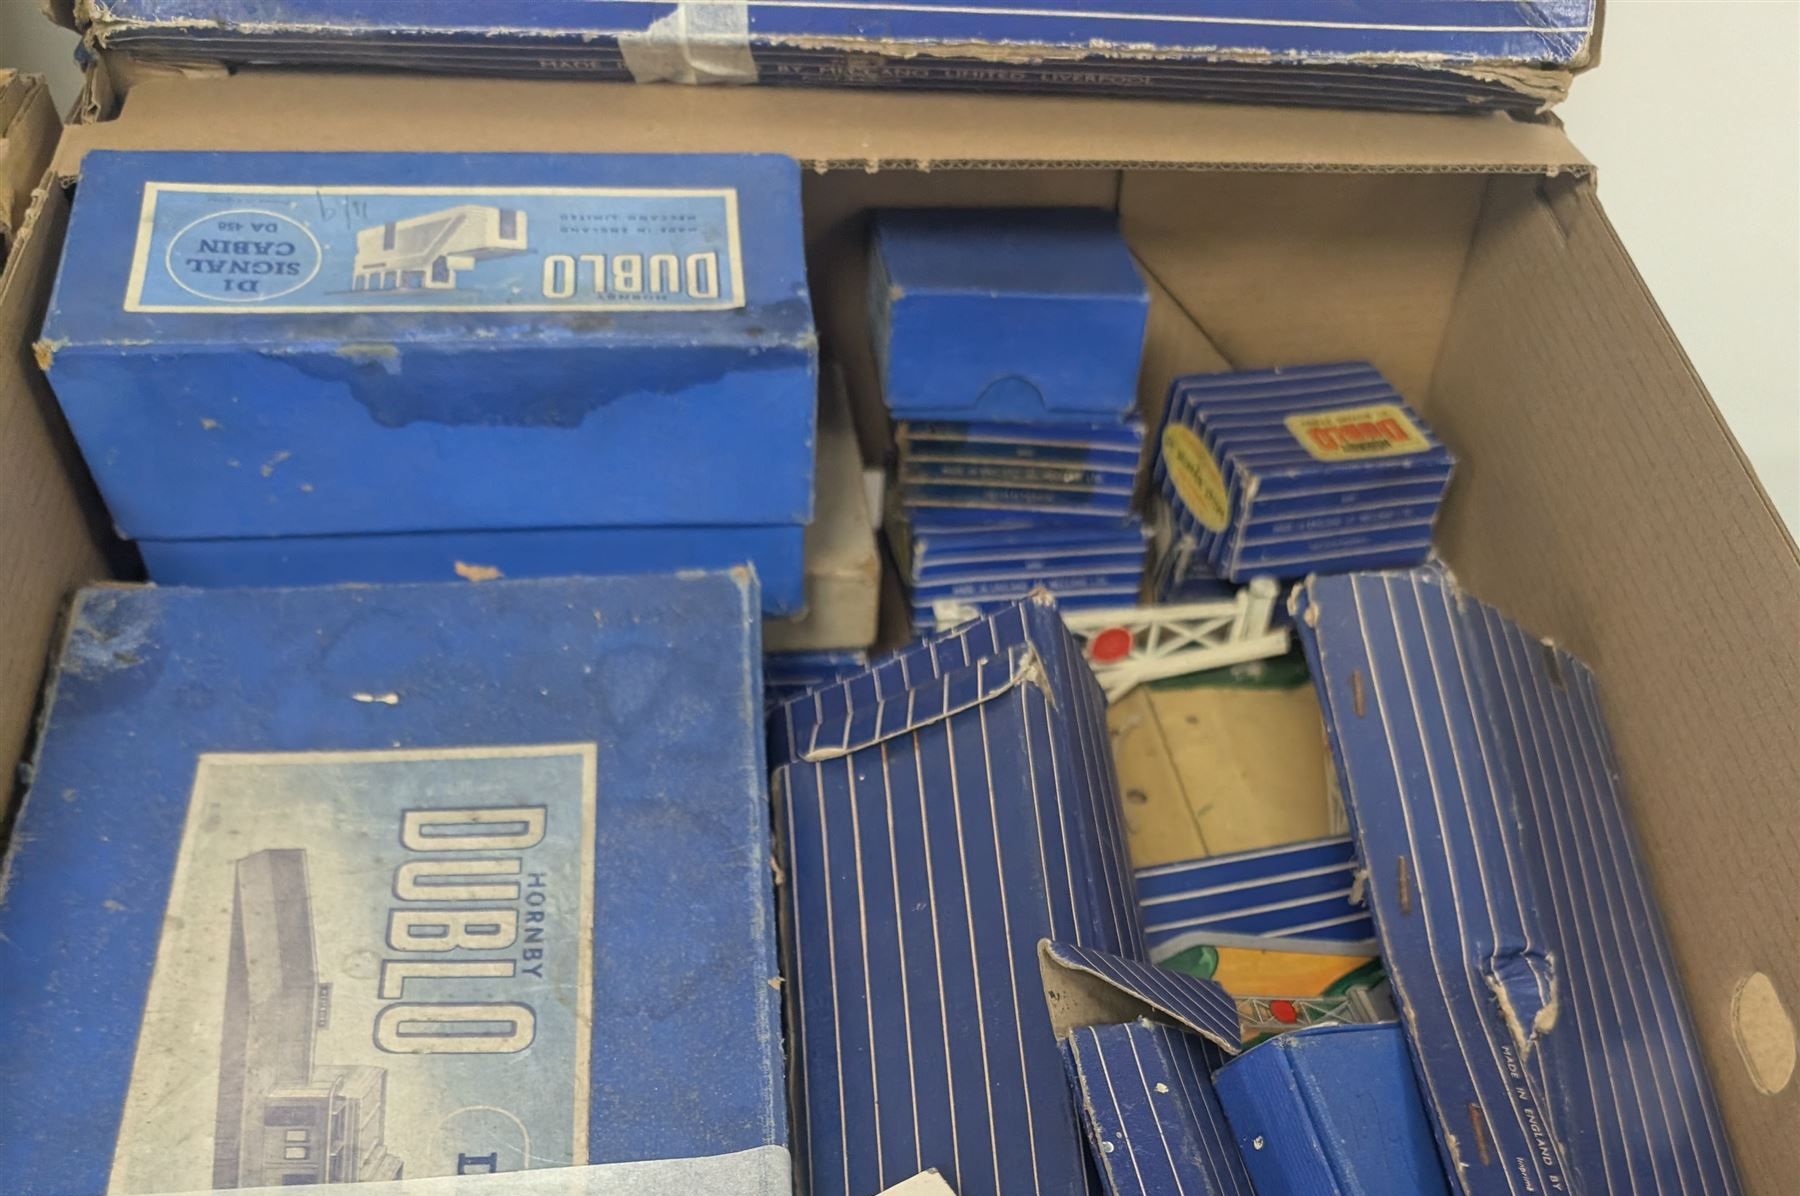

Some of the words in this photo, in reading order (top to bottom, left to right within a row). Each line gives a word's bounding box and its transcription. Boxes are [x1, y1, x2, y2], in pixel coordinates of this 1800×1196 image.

[250, 222, 278, 233] DA
[199, 239, 296, 256] CABIN
[186, 258, 300, 276] SIGNAL
[542, 251, 721, 299] DUBLO
[224, 279, 260, 292] D1
[372, 804, 548, 1055] DUBLO
[521, 872, 548, 979] HORNBY
[1502, 1046, 1520, 1079] MADE
[1516, 1087, 1527, 1101] IN
[1524, 1108, 1553, 1166] ENGLAND
[1549, 1175, 1562, 1191] BY
